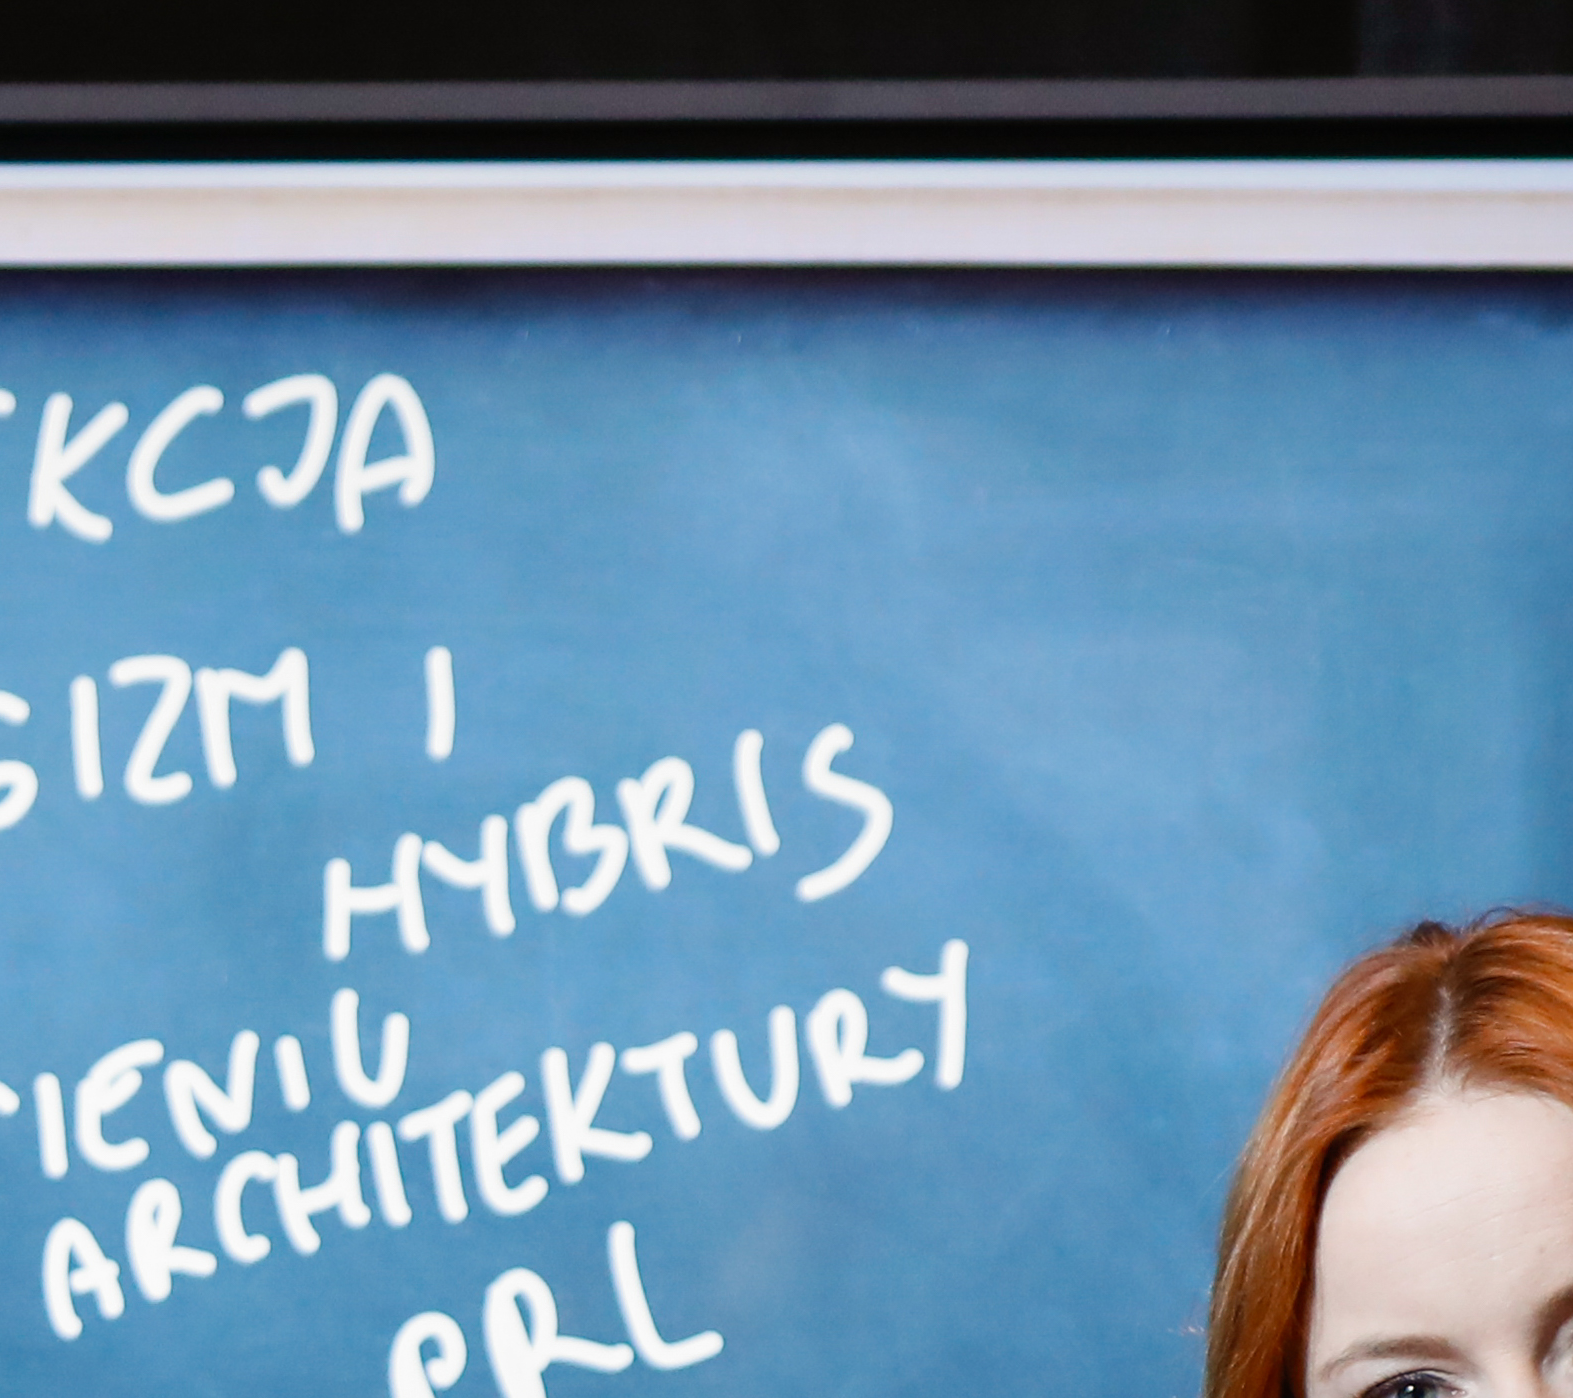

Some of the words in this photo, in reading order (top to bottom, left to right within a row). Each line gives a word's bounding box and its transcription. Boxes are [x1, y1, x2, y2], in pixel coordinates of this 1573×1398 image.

[426, 646, 457, 760] I
[324, 725, 894, 960] HYBRIS
[43, 939, 969, 1339] ARCHITEKTURY
